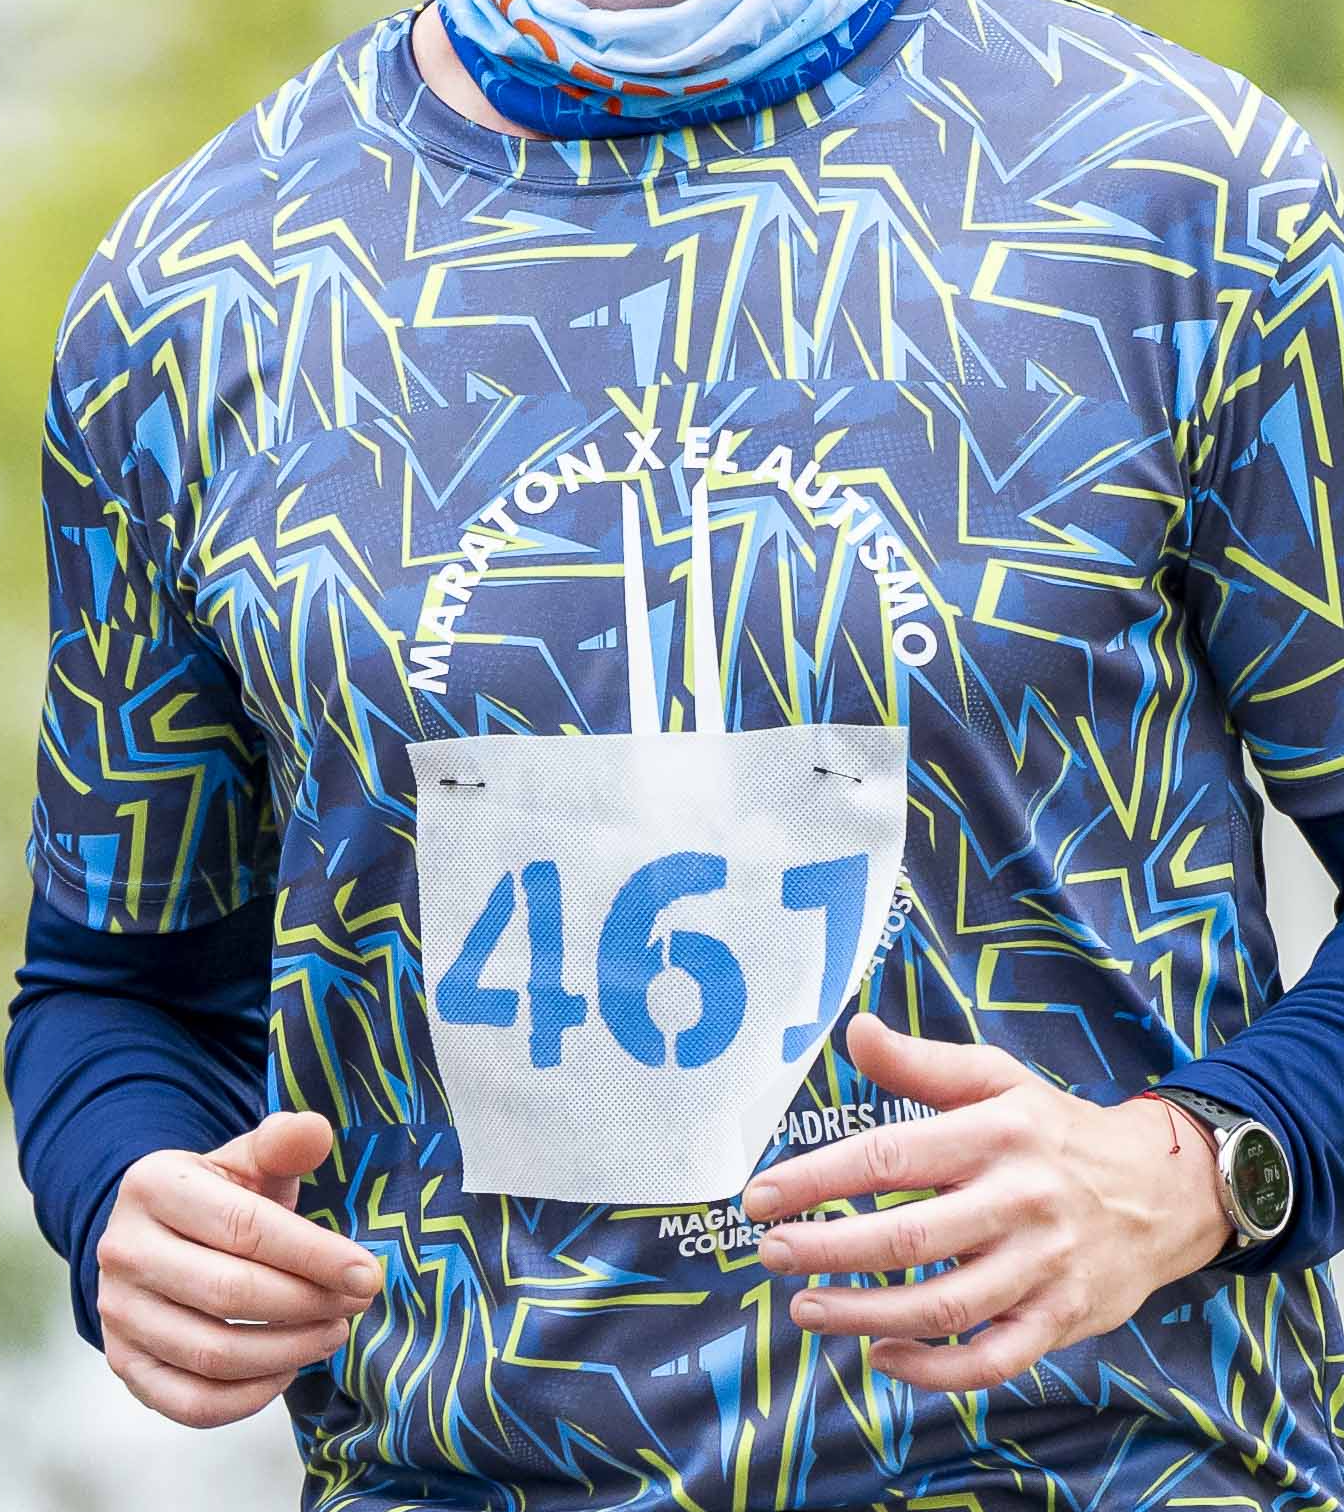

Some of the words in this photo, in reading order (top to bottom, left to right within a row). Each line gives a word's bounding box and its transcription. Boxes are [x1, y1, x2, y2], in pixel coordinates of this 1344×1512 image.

[623, 427, 666, 473] X
[683, 426, 739, 474] EL
[751, 444, 938, 667] AUTISMO
[435, 850, 870, 1069] 461
[771, 1103, 876, 1146] PADRES
[658, 1205, 747, 1239] MAGN
[678, 1223, 767, 1258] COURS
